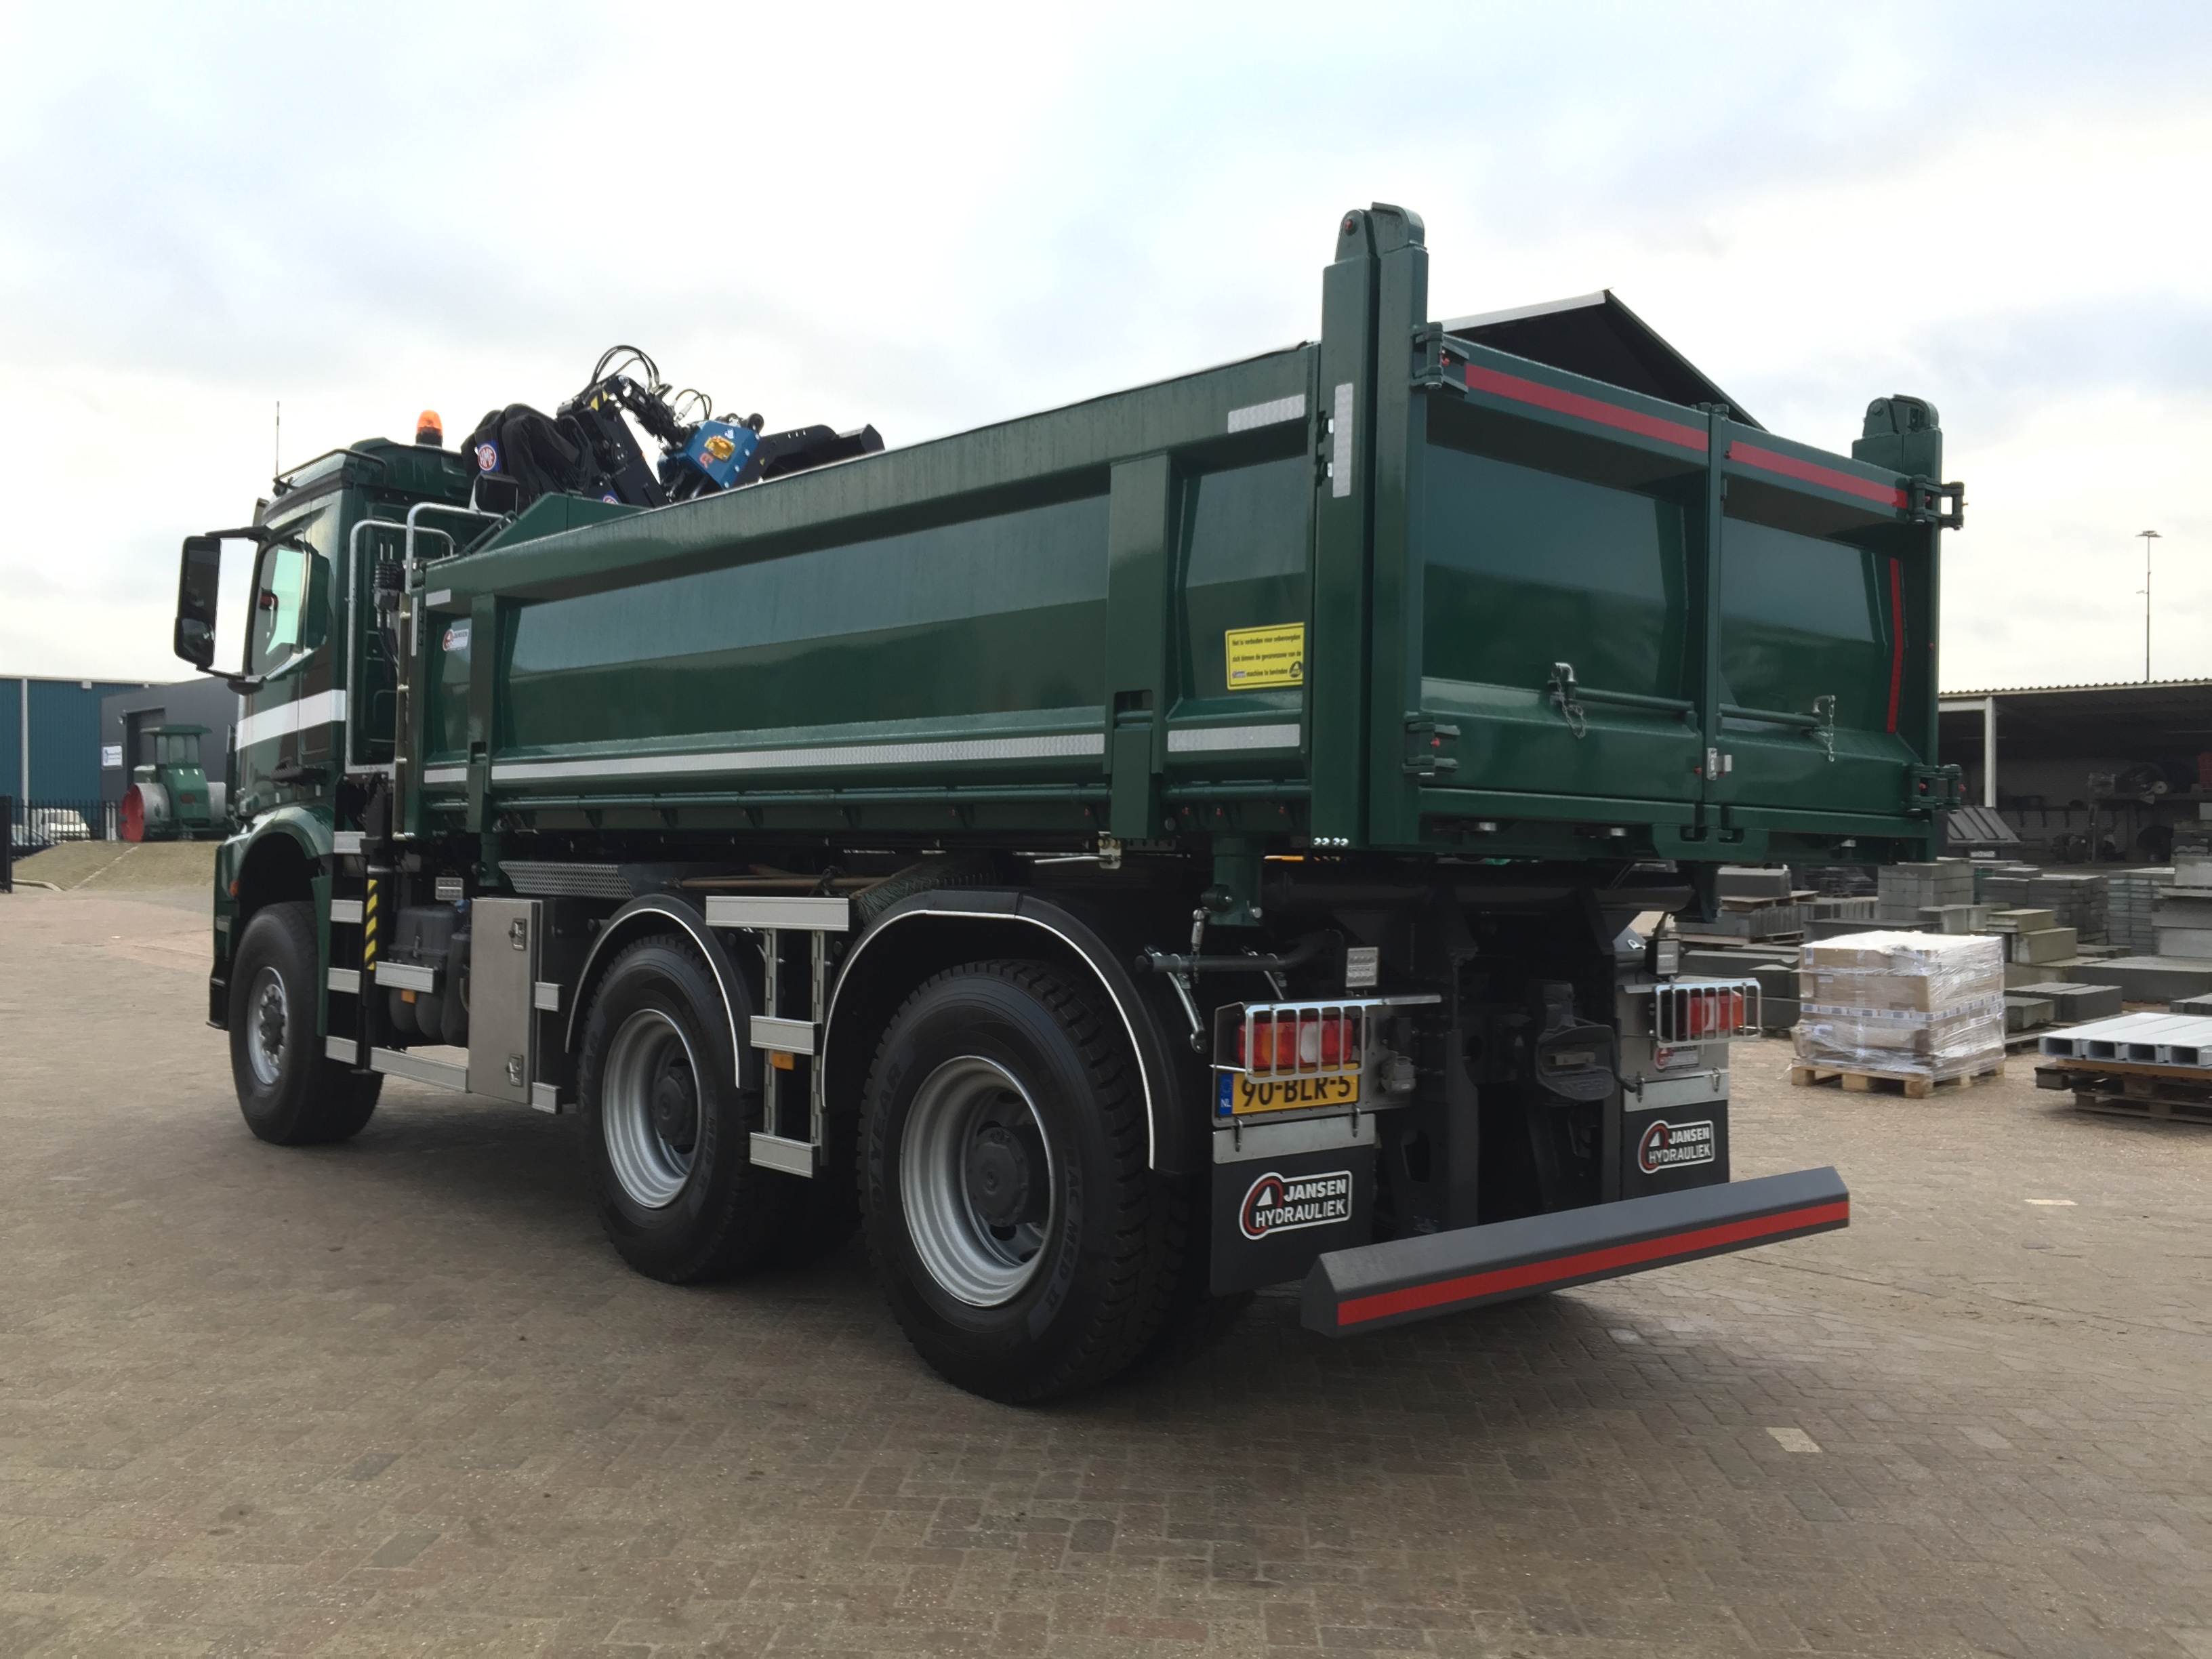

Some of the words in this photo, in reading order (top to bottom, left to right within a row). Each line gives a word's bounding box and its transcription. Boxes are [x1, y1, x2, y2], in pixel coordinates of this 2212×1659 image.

[479, 448, 493, 467] HMF
[1242, 1076, 1351, 1107] 90-BLR-5
[1221, 1098, 1231, 1107] NL
[1668, 1127, 1710, 1145] JANSEN
[1648, 1143, 1711, 1164] HYDRAULIEK
[1284, 1179, 1347, 1202] JANSEN
[1256, 1199, 1346, 1228] HYDRAULIEK
